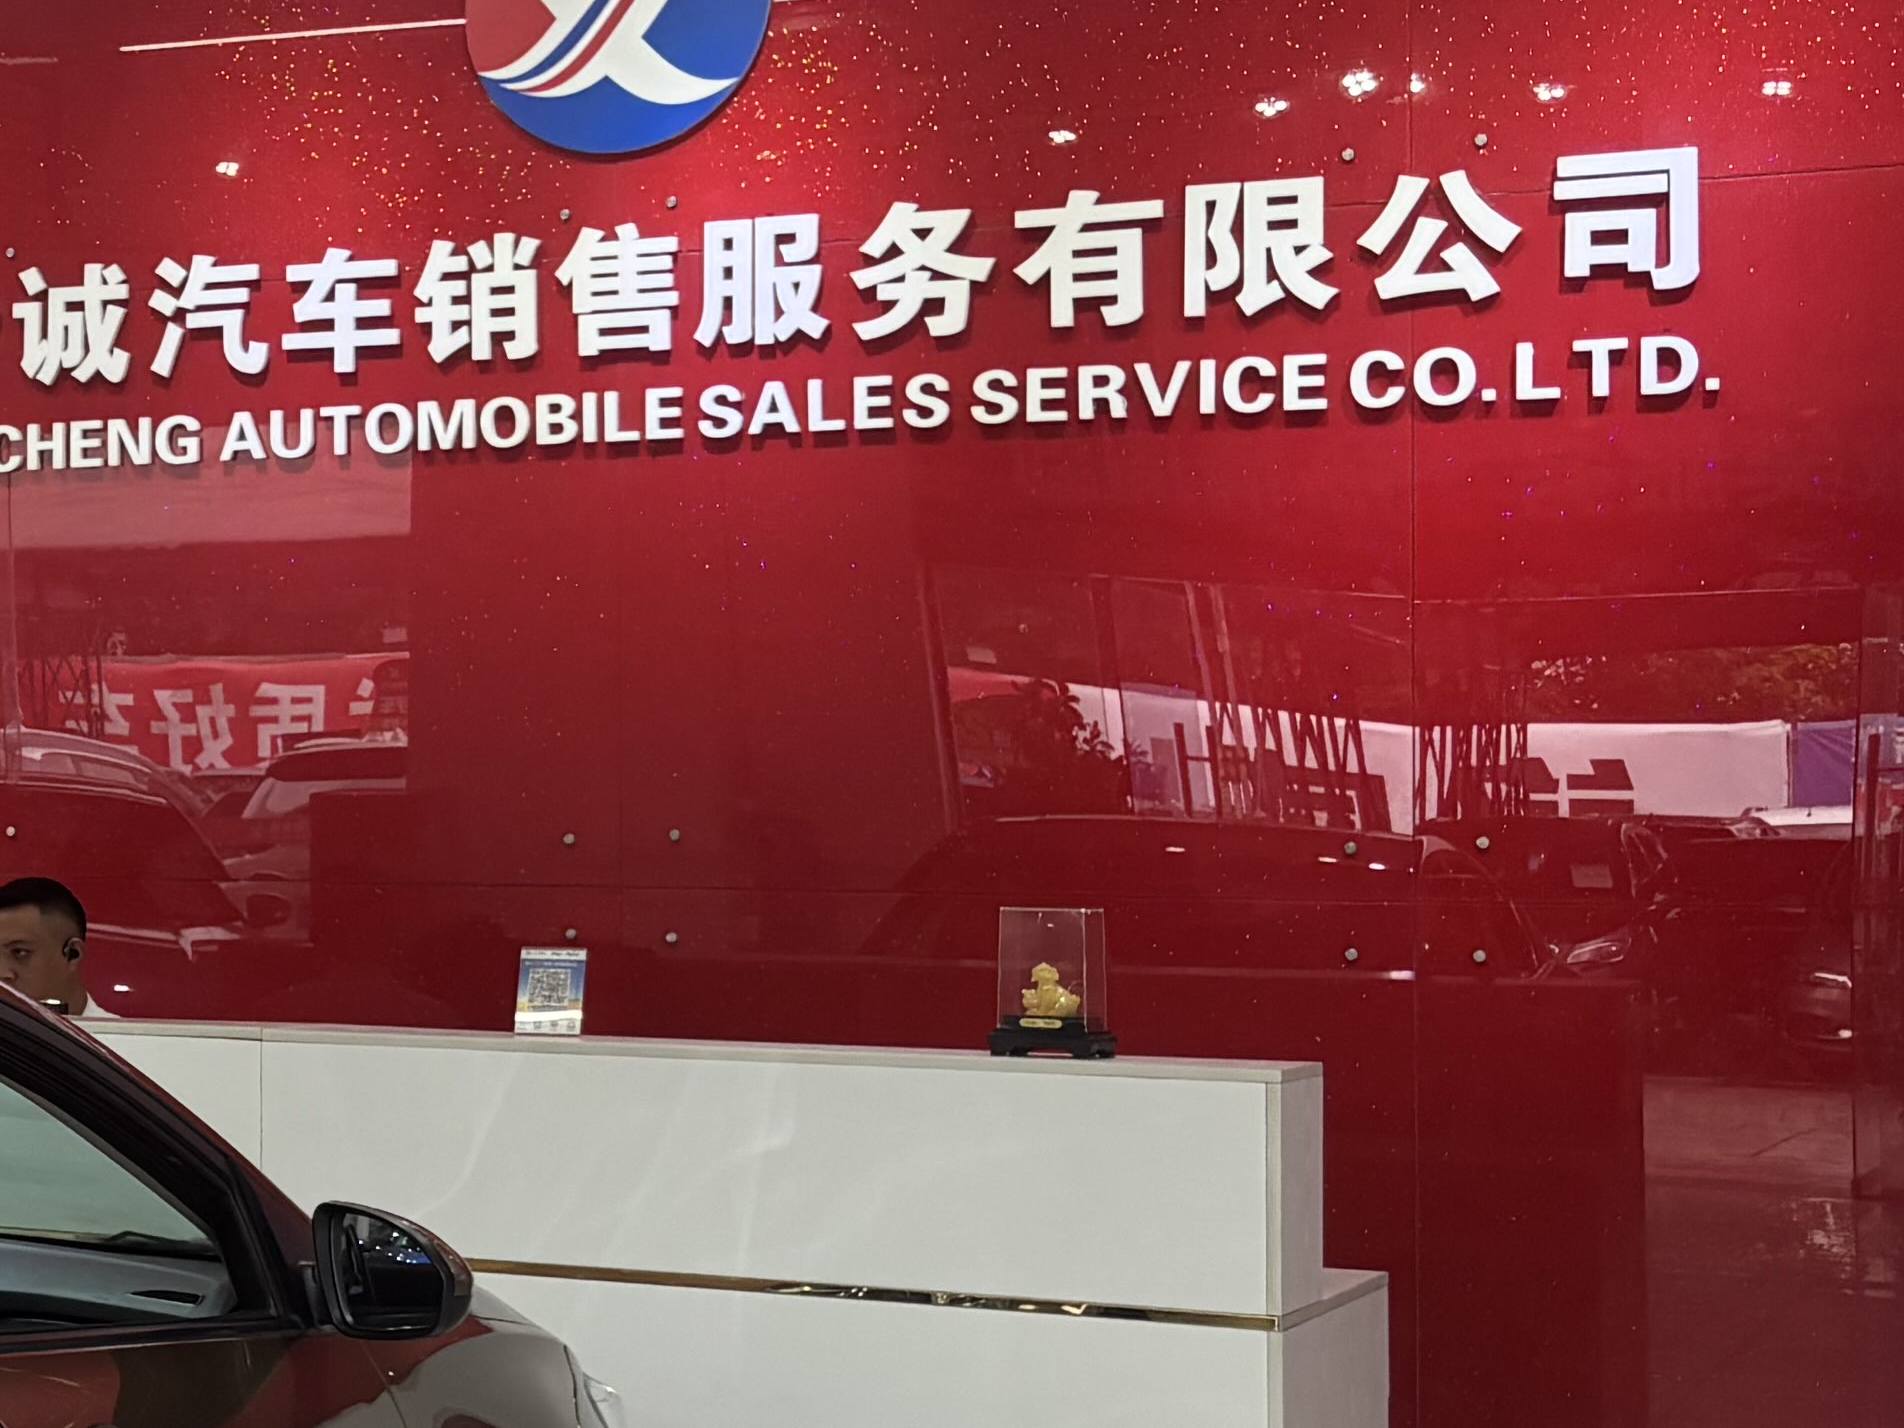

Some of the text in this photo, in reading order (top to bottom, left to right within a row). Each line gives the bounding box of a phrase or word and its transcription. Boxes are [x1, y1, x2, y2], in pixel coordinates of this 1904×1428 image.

[218, 386, 684, 464] AUTOMOBILE
[697, 372, 952, 440] SALES
[969, 352, 1329, 426] SERVICE
